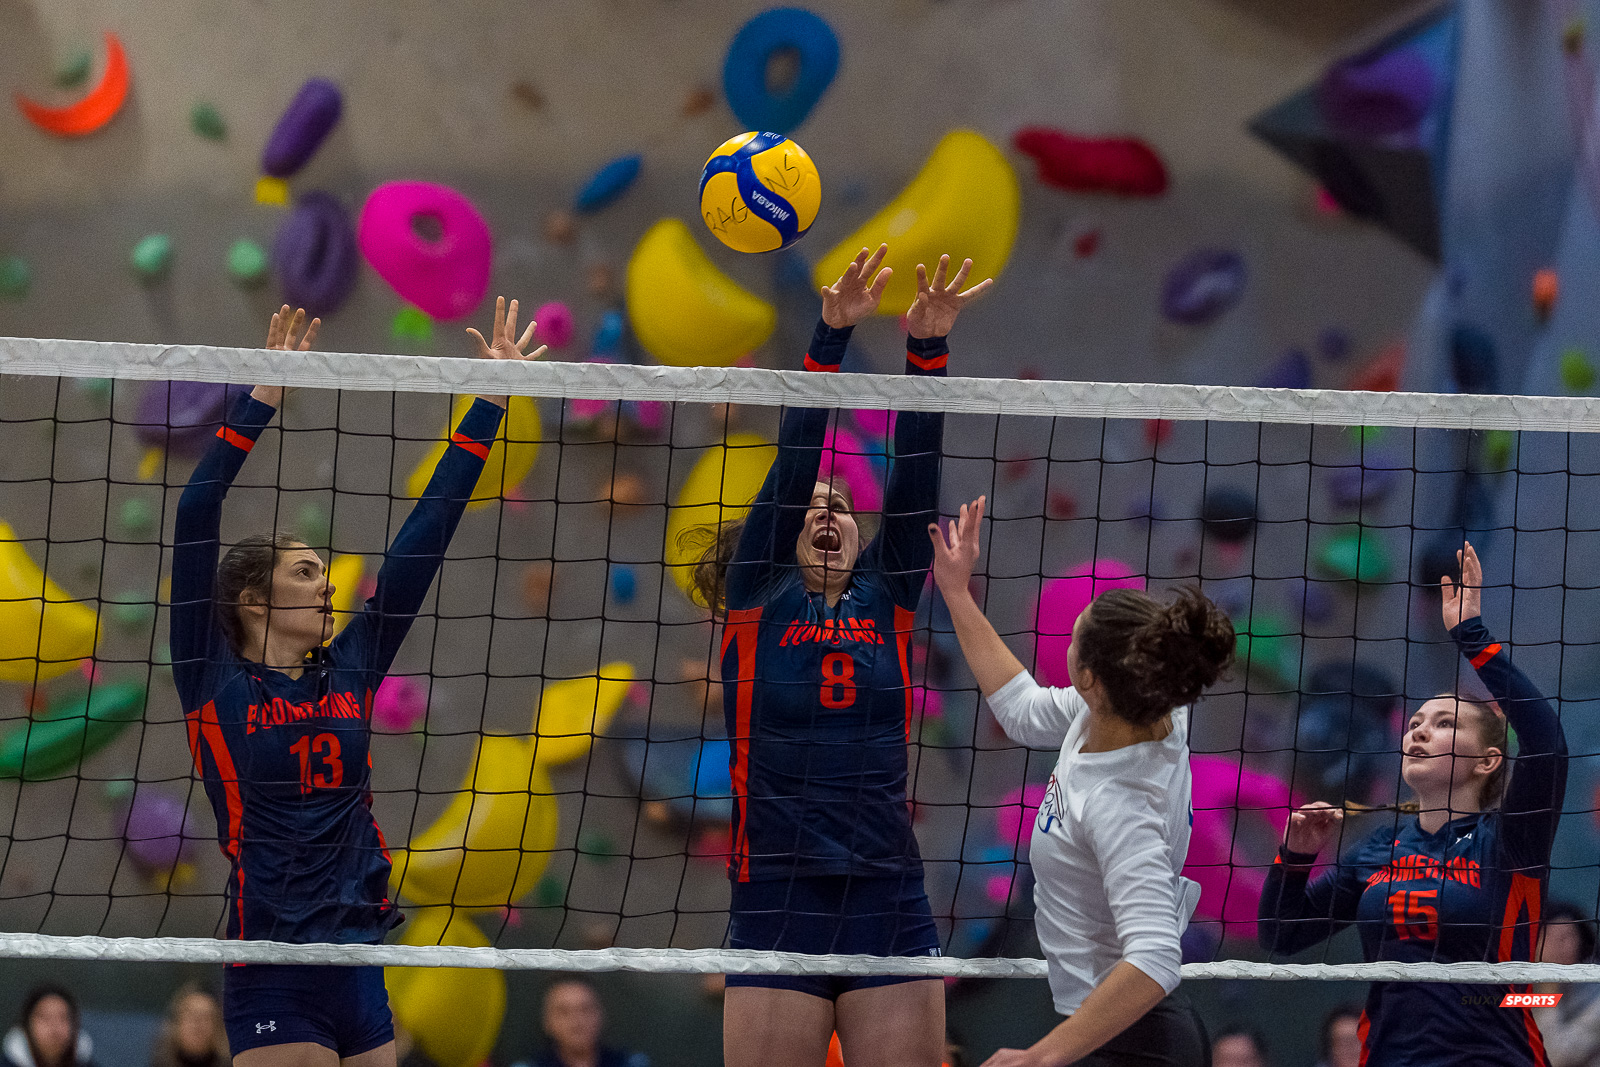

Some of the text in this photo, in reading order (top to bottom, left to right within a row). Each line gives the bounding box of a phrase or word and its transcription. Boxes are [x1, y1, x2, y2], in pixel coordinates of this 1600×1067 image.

[820, 652, 857, 709] 8
[289, 733, 344, 794] 13
[1388, 889, 1438, 941] 15
